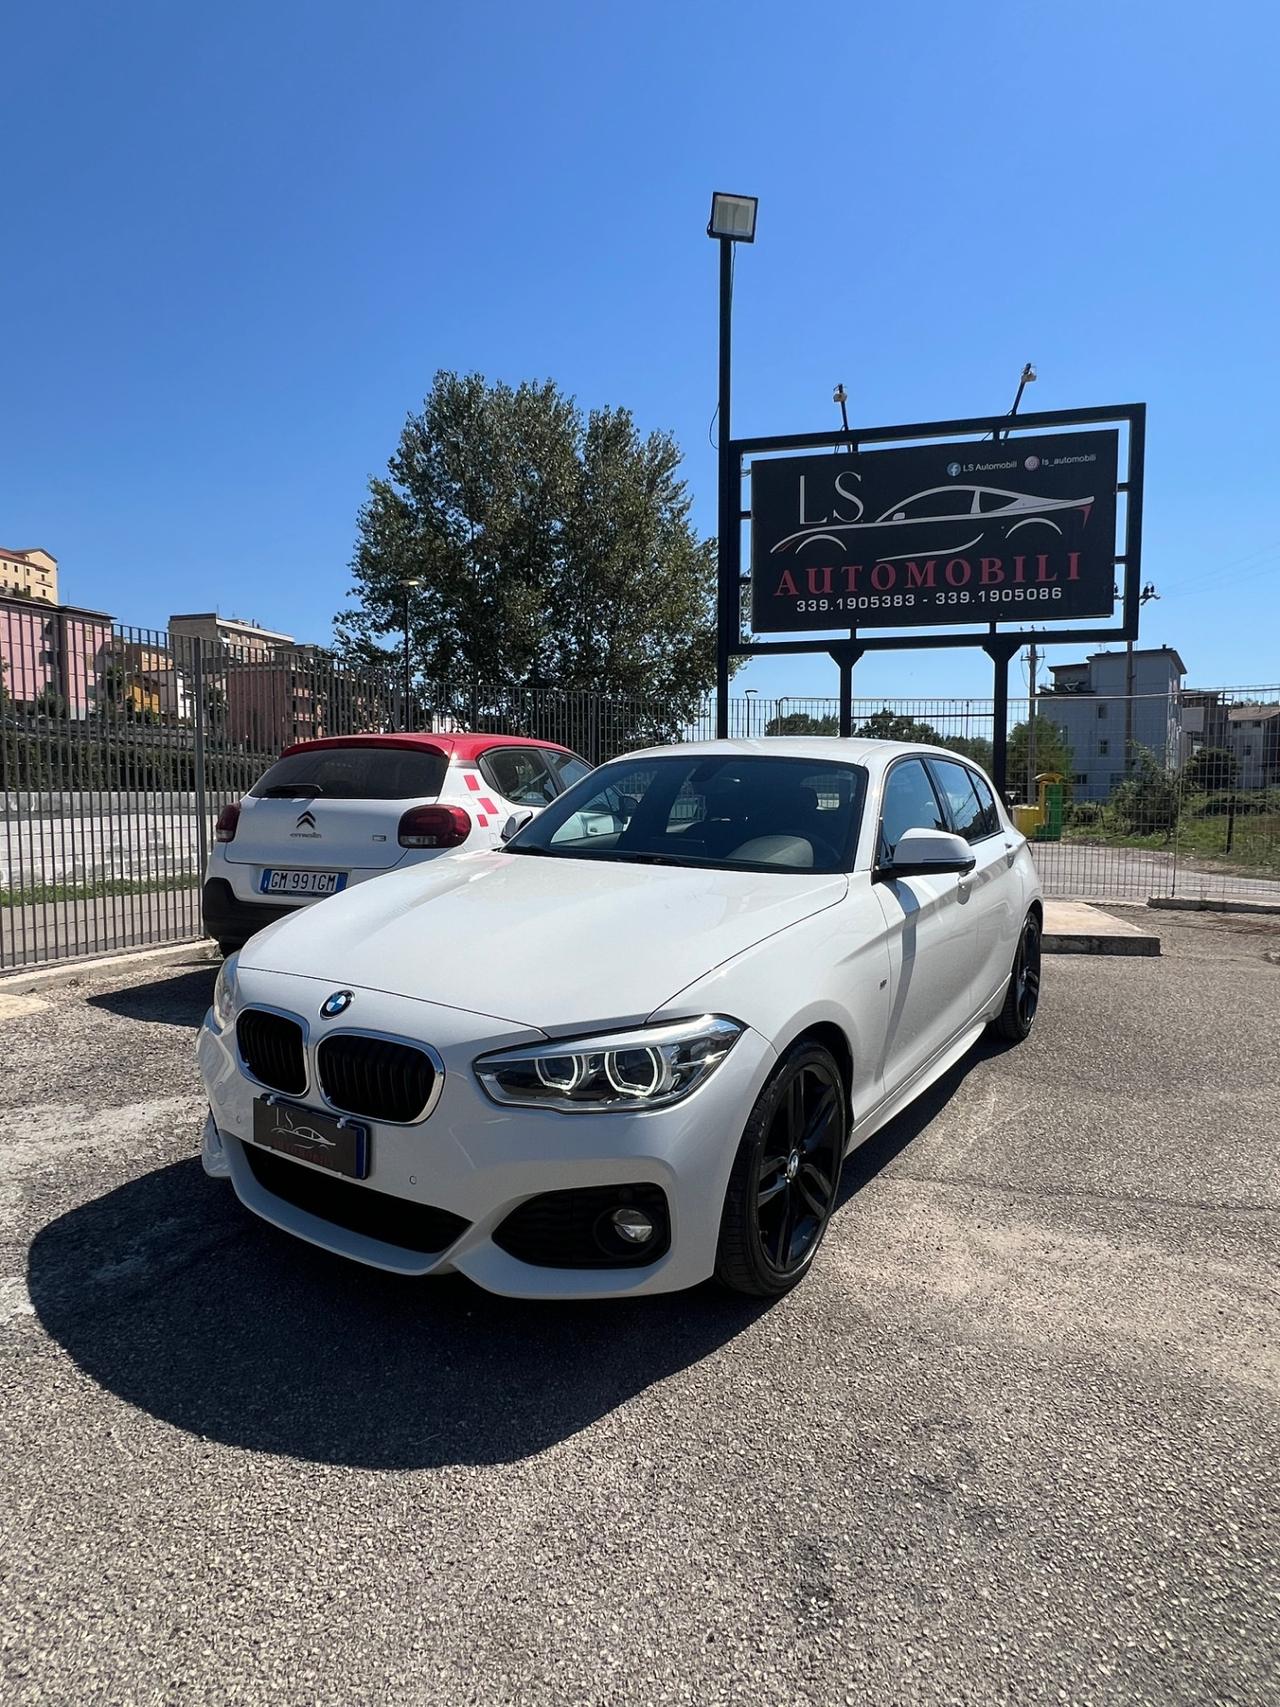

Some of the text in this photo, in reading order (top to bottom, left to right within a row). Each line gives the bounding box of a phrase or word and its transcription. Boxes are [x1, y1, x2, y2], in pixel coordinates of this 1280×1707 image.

[963, 463, 974, 472] LS
[800, 471, 864, 524] LS
[773, 552, 1082, 596] AUTOMOBILI
[796, 594, 916, 612] 339.1905383
[935, 587, 1063, 605] 339.1905086
[271, 872, 337, 891] GM 991GM
